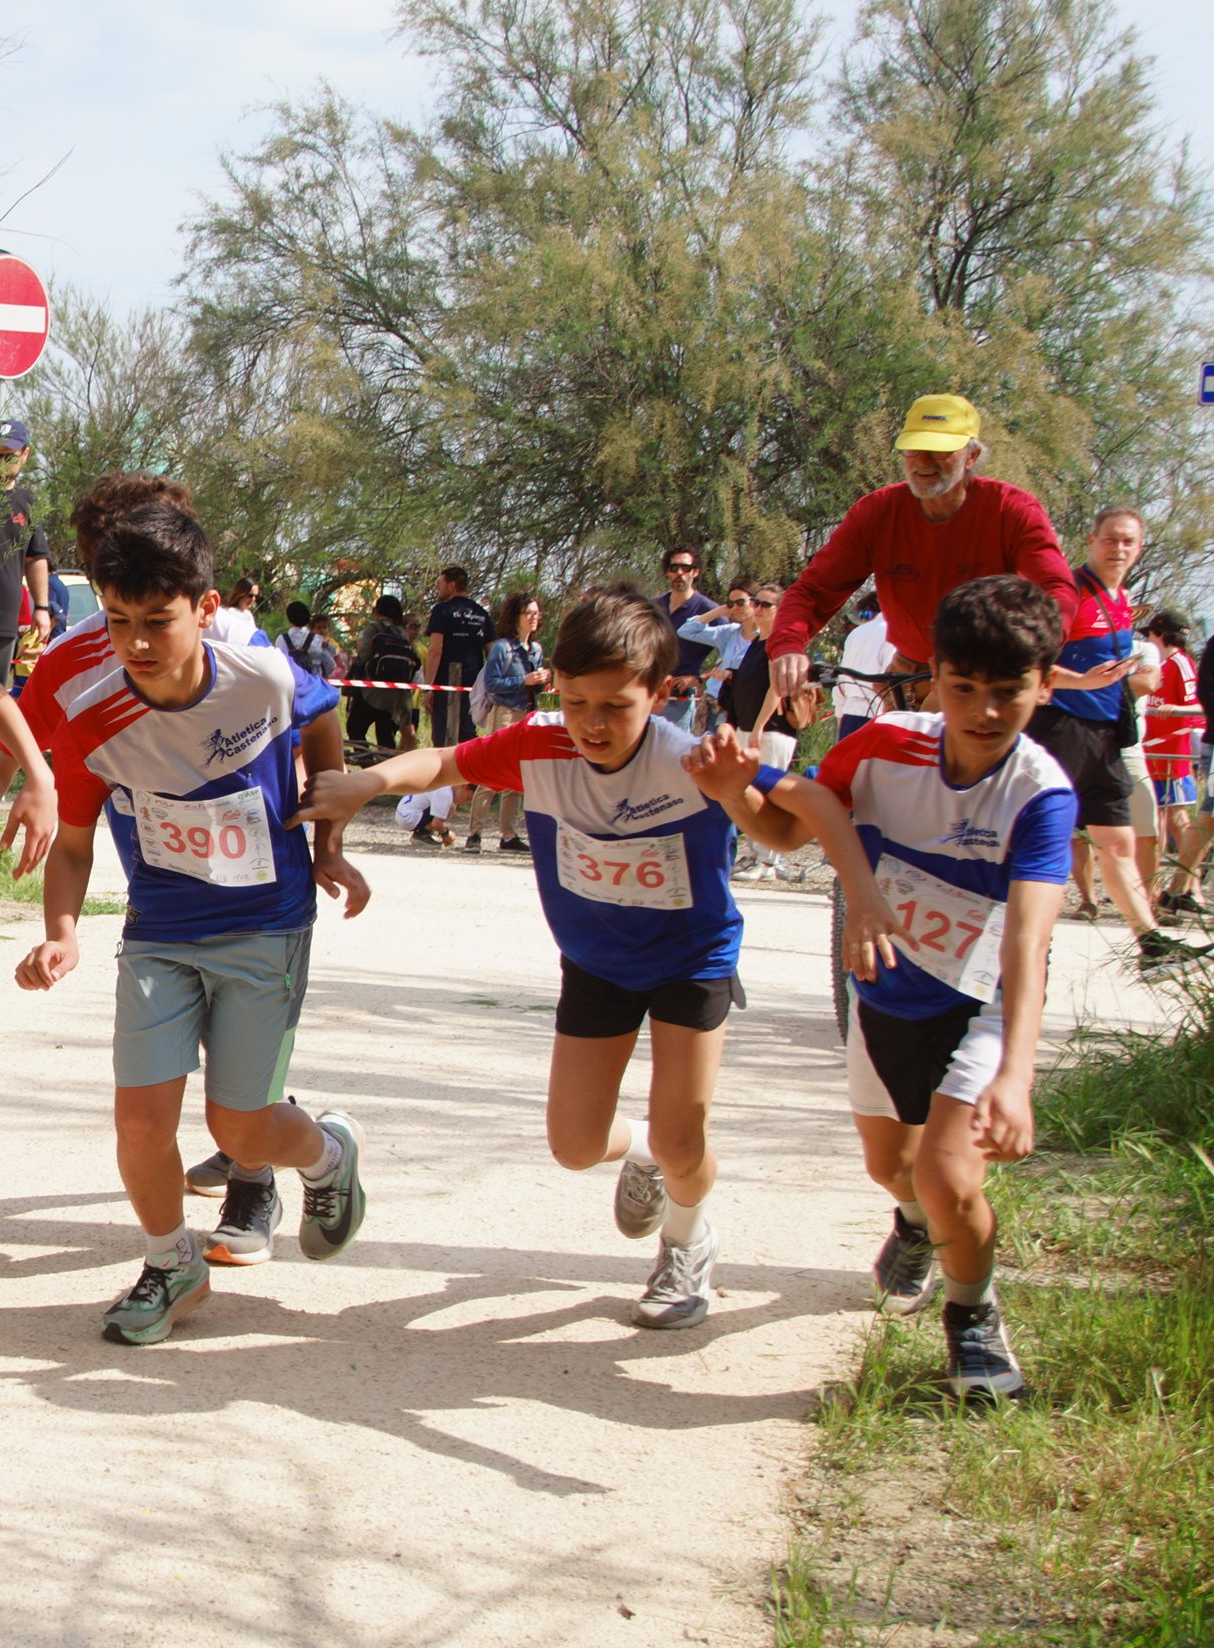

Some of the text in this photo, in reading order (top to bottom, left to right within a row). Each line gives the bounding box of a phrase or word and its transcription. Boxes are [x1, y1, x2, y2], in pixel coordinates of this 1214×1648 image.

[225, 717, 267, 748] Atletica
[159, 821, 246, 859] 390
[576, 853, 666, 889] 376
[895, 900, 984, 960] 127
